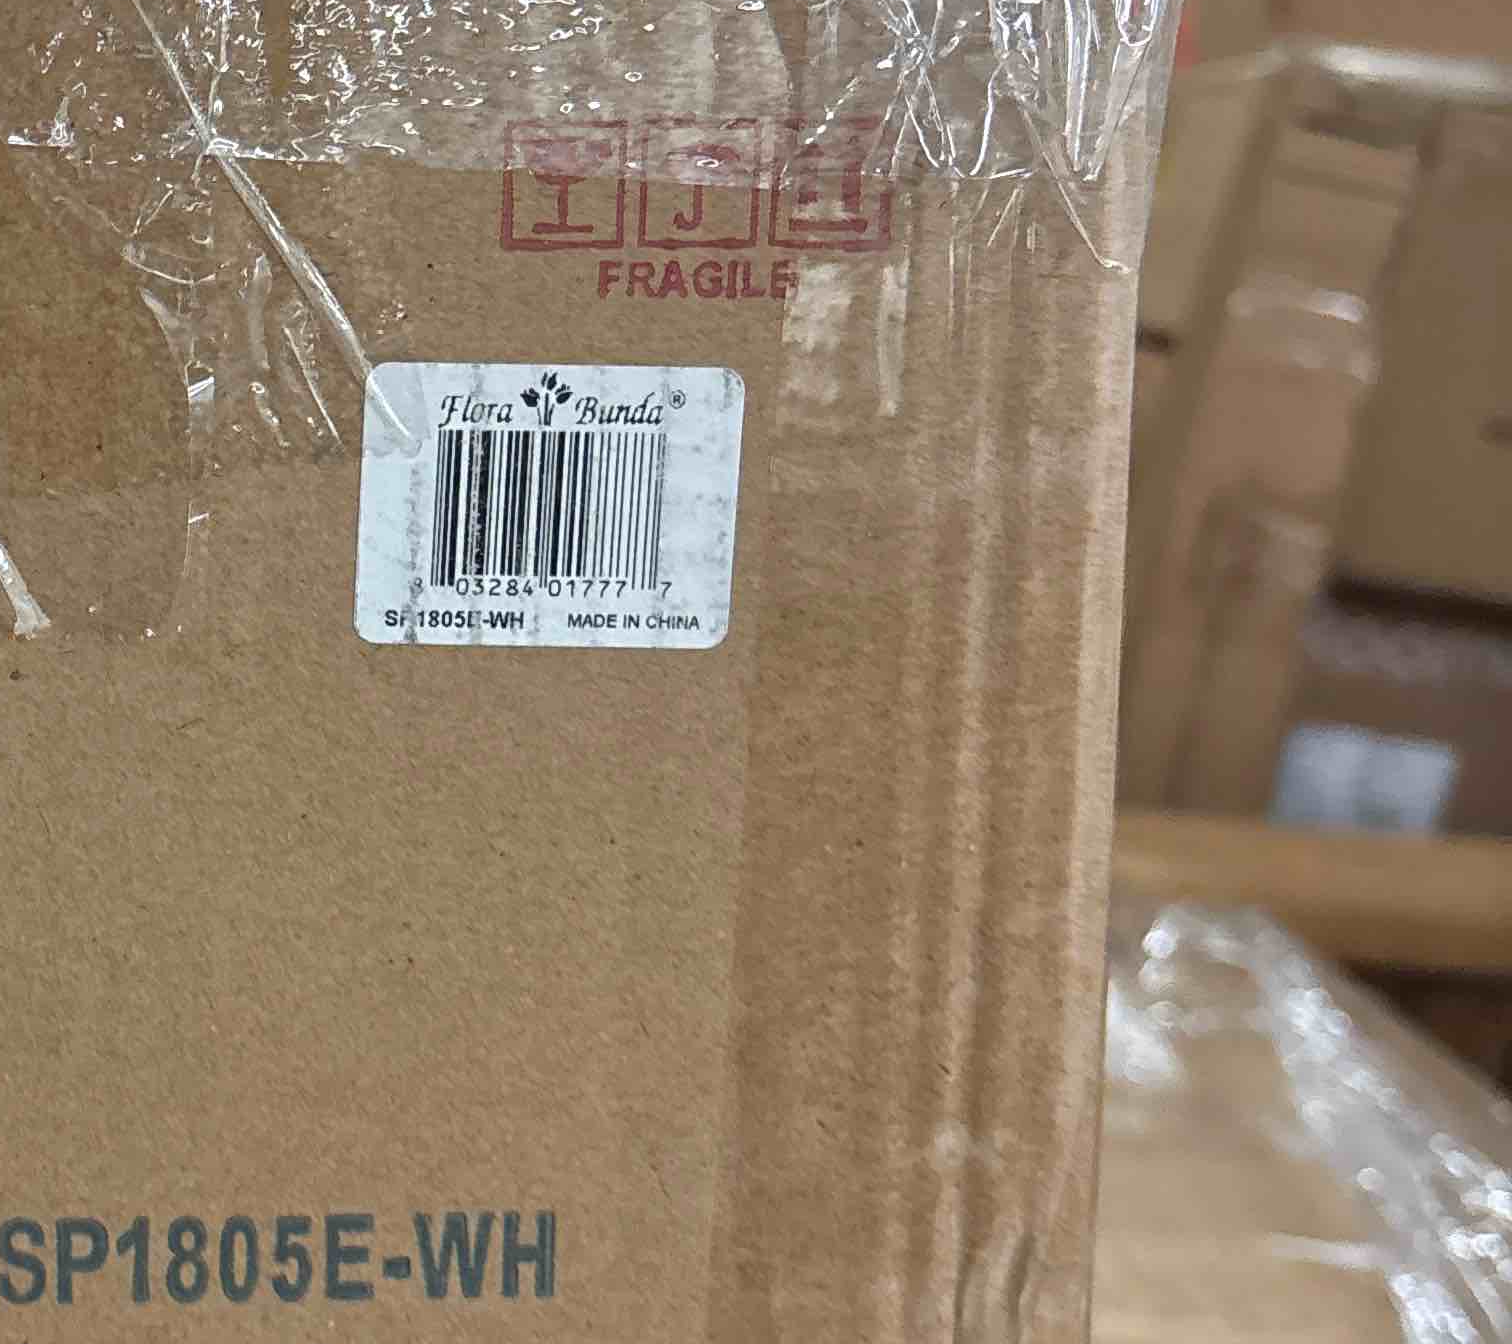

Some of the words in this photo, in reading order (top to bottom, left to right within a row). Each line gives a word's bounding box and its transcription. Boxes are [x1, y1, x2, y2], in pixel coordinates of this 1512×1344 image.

[597, 259, 799, 299] FRAGILE
[438, 394, 513, 428] Flora
[455, 577, 534, 597] 03284
[548, 579, 627, 599] 01777
[568, 613, 617, 629] MADE
[623, 614, 640, 629] IN
[646, 615, 700, 630] CHINA
